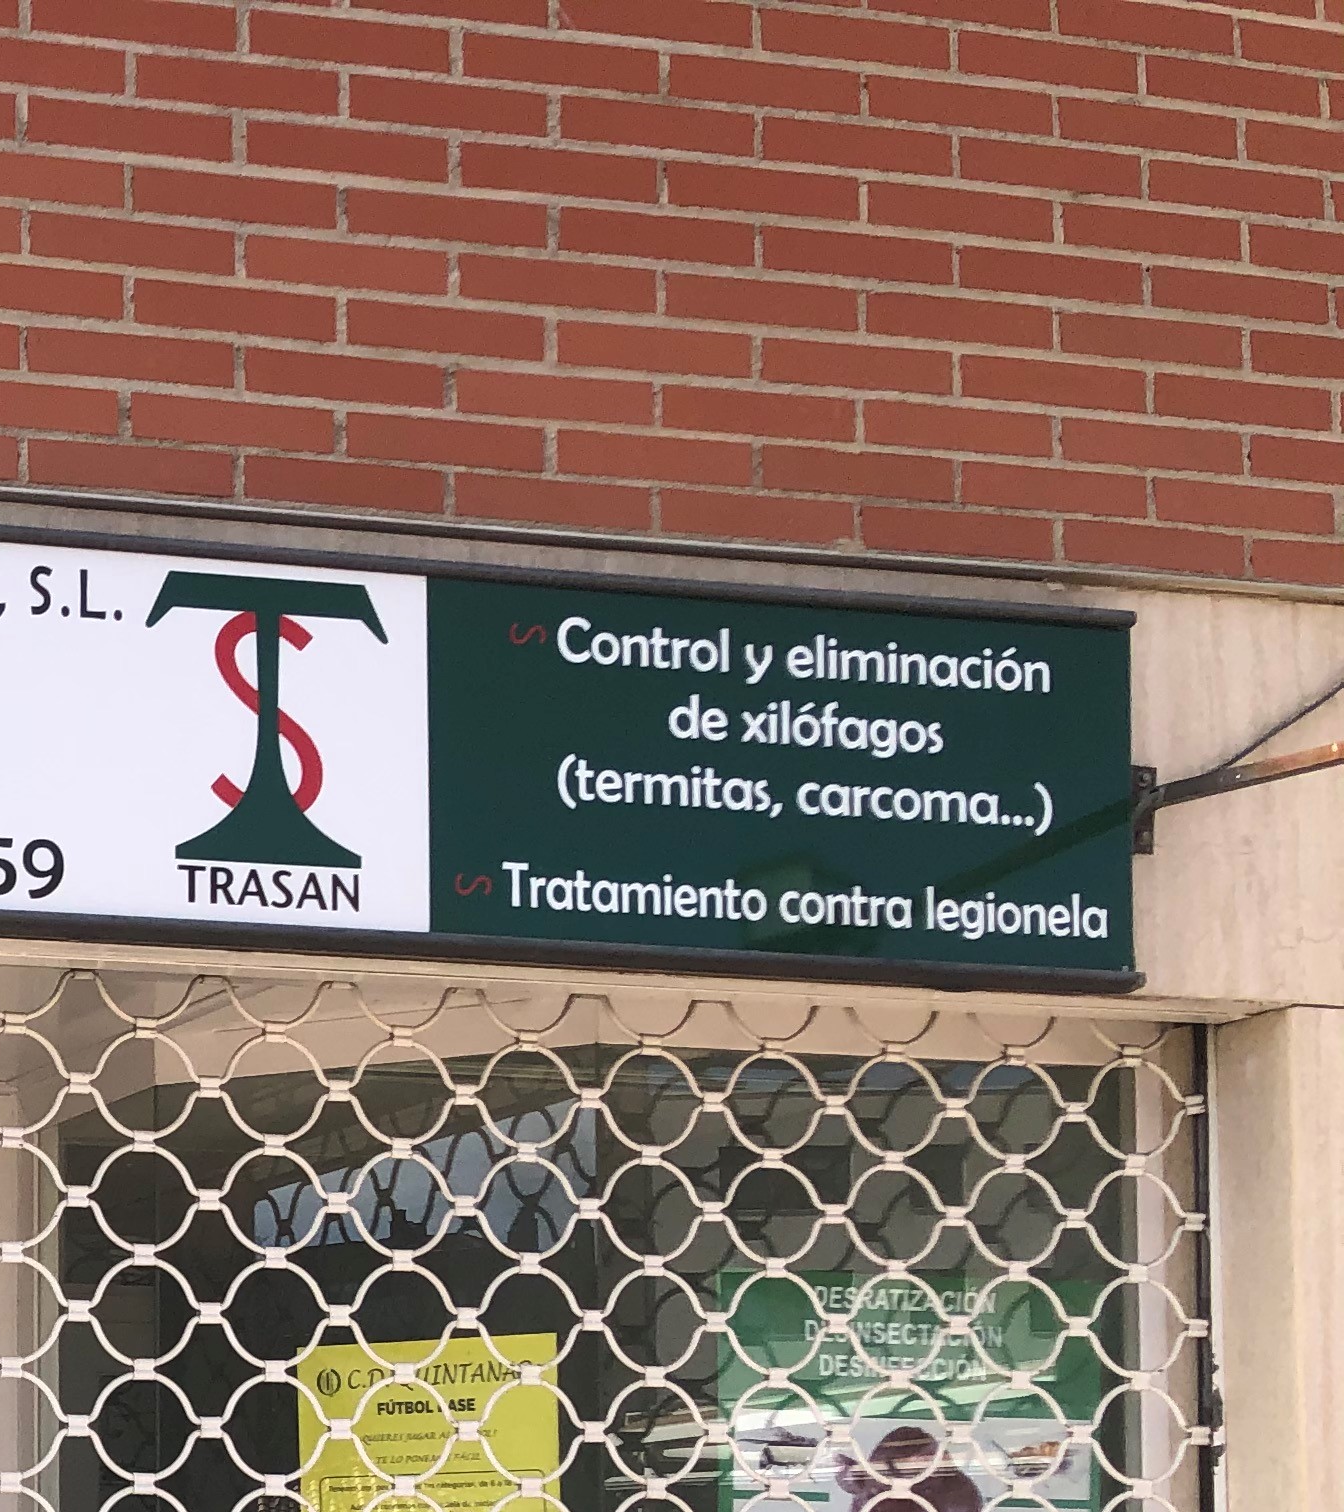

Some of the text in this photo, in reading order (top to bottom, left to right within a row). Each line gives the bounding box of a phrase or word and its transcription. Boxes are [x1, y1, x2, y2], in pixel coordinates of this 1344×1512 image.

[30, 566, 122, 621] S.L.
[557, 617, 1050, 692] Control y eliminación
[669, 694, 943, 758] de xilófagos
[558, 754, 1052, 836] (termitas, carcoma...)
[177, 865, 359, 912] TRASAN
[502, 862, 1107, 939] Tratamiento contra legionela
[804, 1319, 1002, 1347] DNSECTÓN
[394, 1360, 542, 1391] UINTANA
[819, 1354, 986, 1381] DESFECIÓN
[378, 1398, 476, 1415] FÚTBOL ASE
